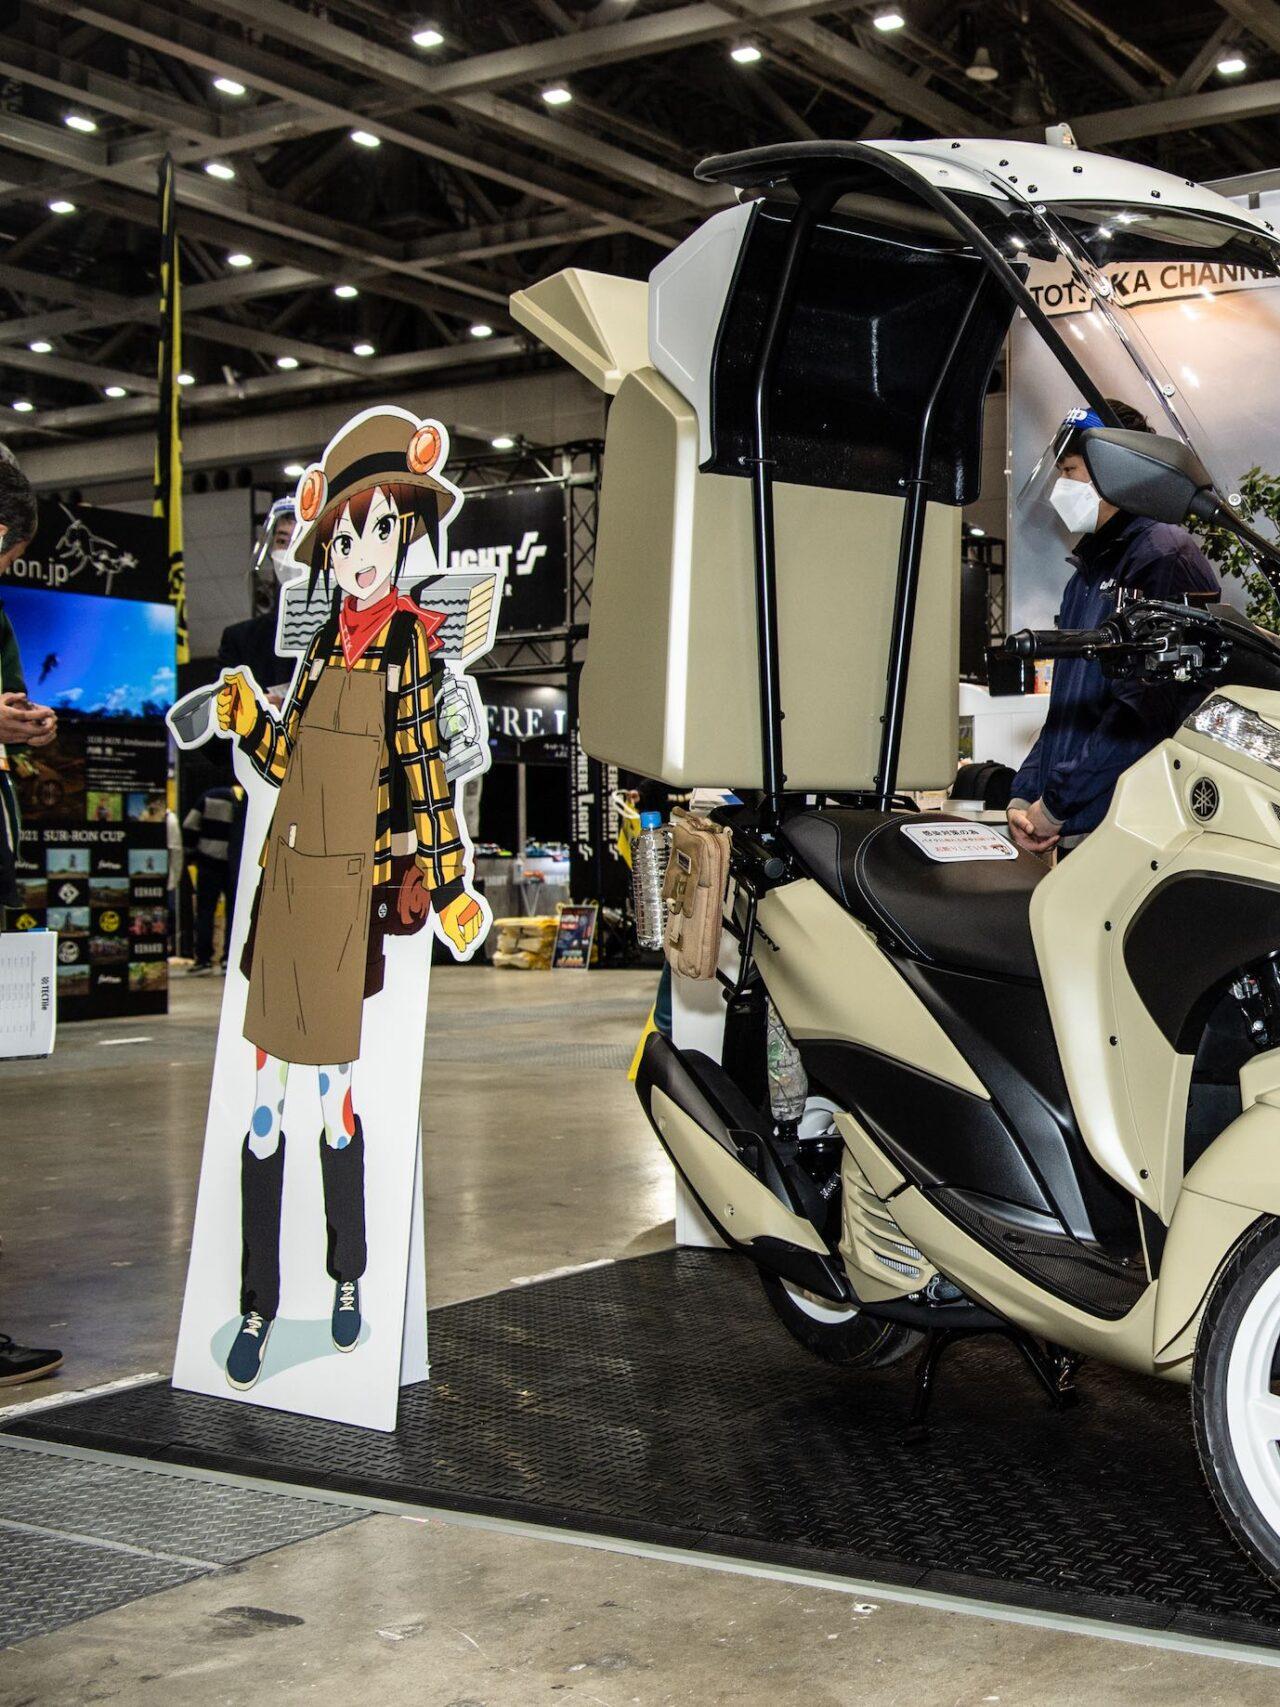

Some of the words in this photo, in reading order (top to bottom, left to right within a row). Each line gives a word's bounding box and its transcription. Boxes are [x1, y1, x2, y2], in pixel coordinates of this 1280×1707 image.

[1029, 269, 1151, 307] TOTKA
[450, 545, 513, 578] IGHT
[484, 705, 545, 736] ERE
[43, 830, 99, 842] SUR-RON
[100, 830, 126, 842] CUP
